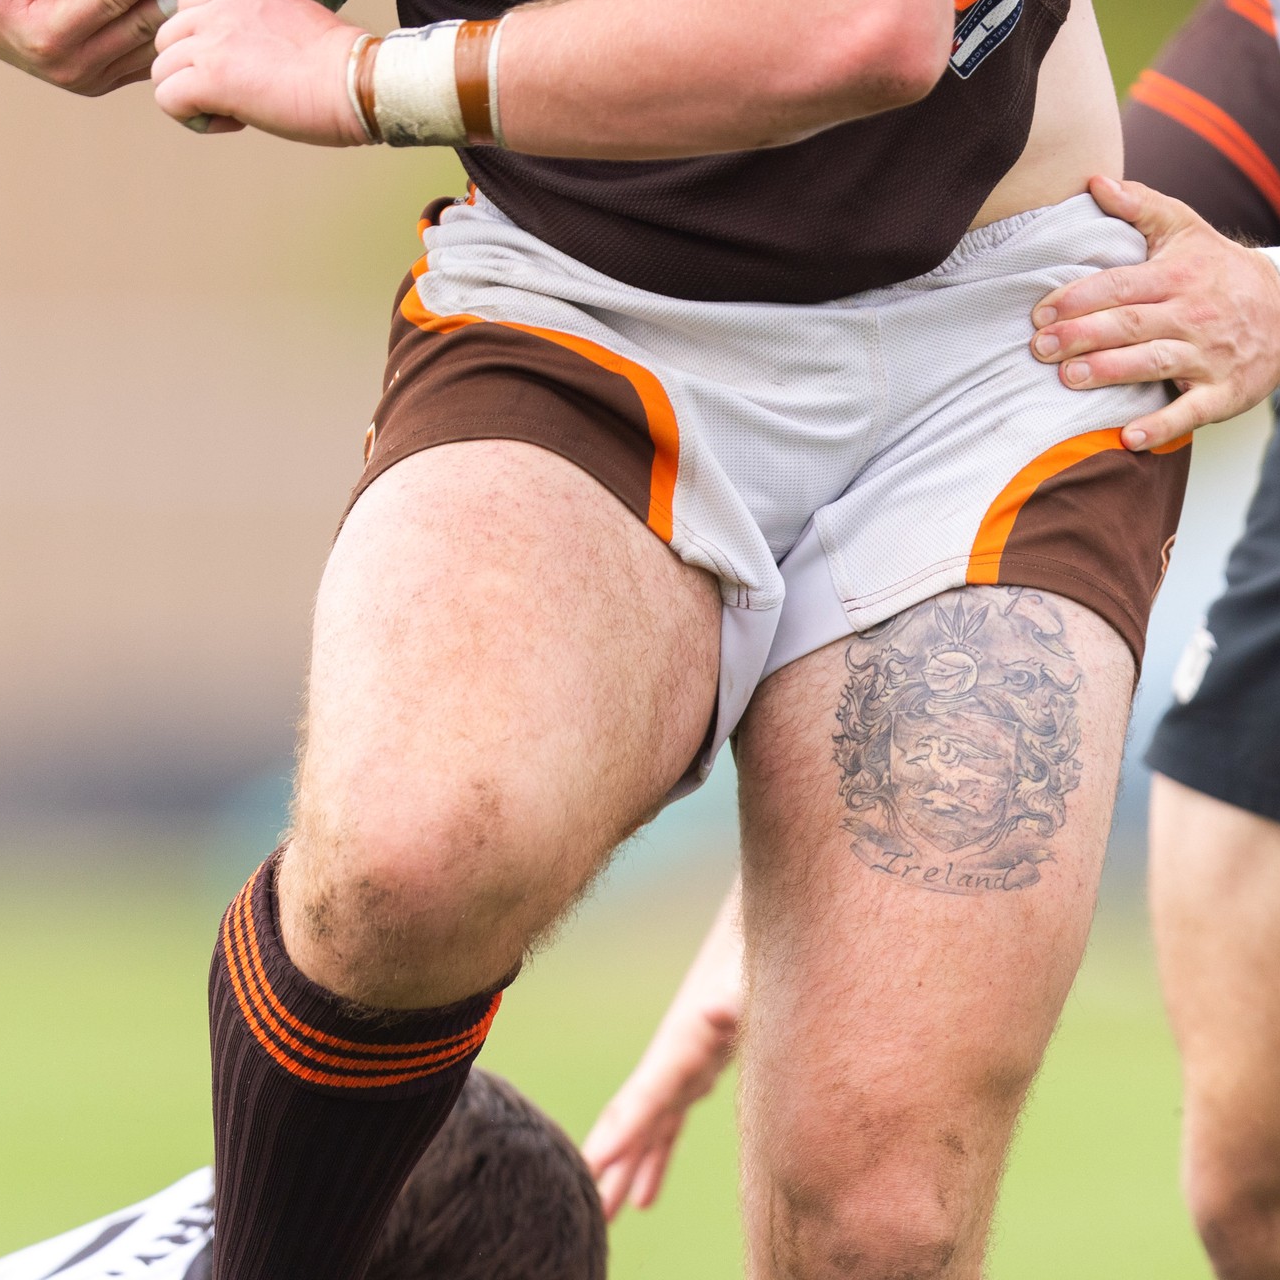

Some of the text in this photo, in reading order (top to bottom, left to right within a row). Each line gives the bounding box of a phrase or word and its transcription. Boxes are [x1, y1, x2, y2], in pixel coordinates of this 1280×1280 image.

[965, 46, 986, 69] MADE
[993, 25, 1009, 40] THE
[871, 851, 1022, 892] Ireland
